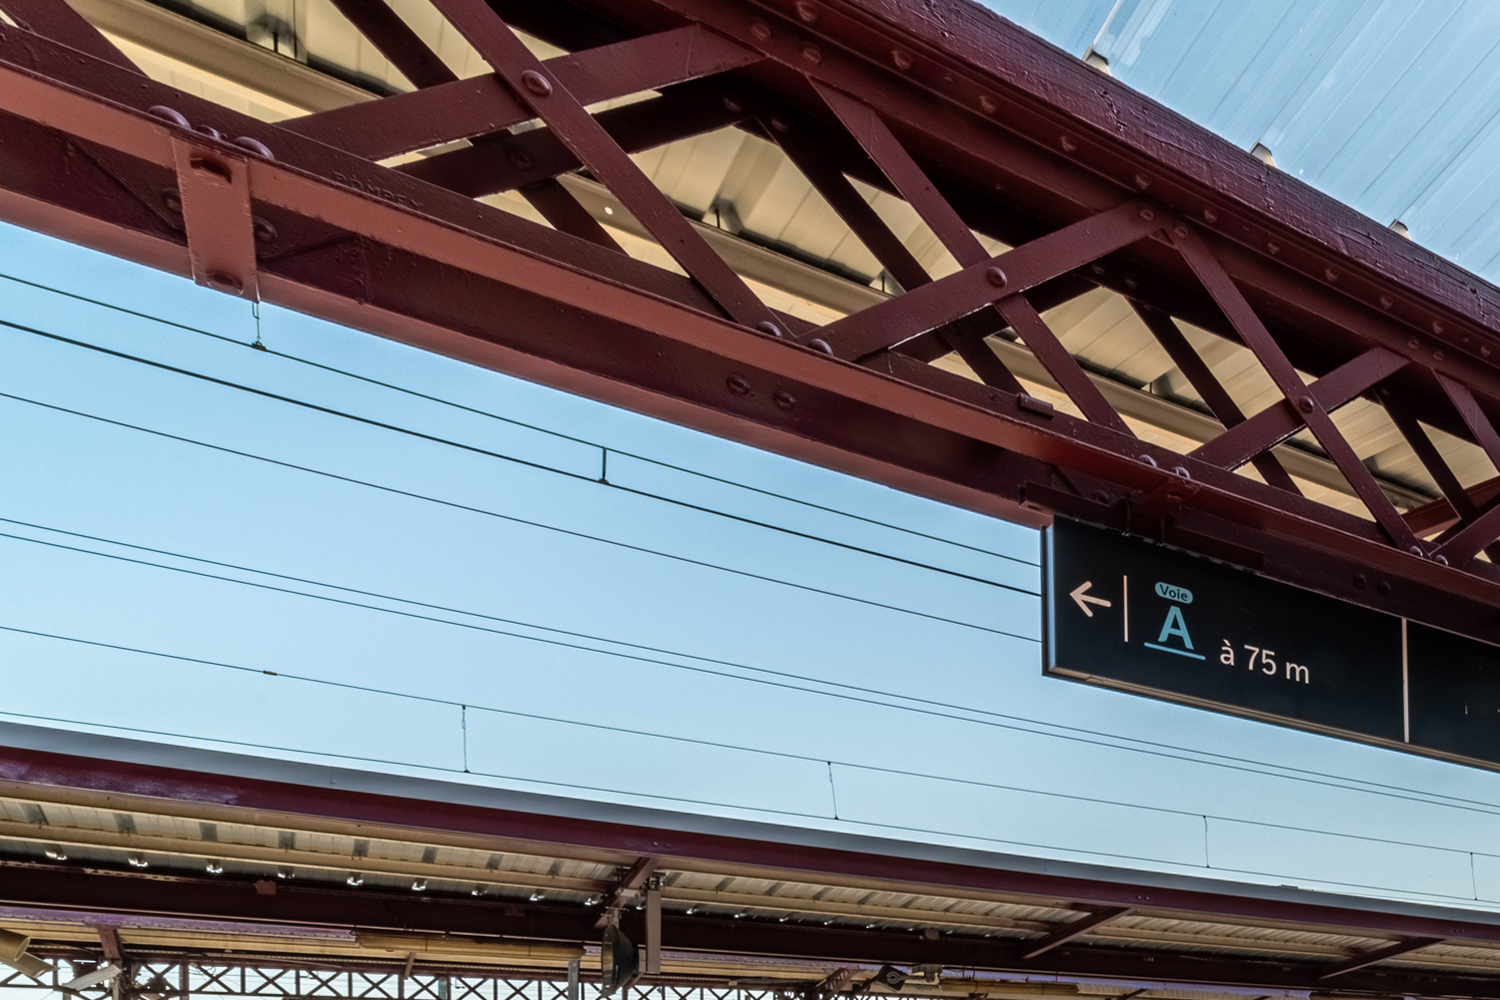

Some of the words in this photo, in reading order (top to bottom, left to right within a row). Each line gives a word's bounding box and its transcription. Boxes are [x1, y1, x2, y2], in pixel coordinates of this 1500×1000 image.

[1160, 584, 1188, 602] Voie
[1158, 606, 1194, 650] A
[1220, 638, 1234, 666] à
[1244, 644, 1276, 675] 75
[1286, 662, 1309, 684] m
